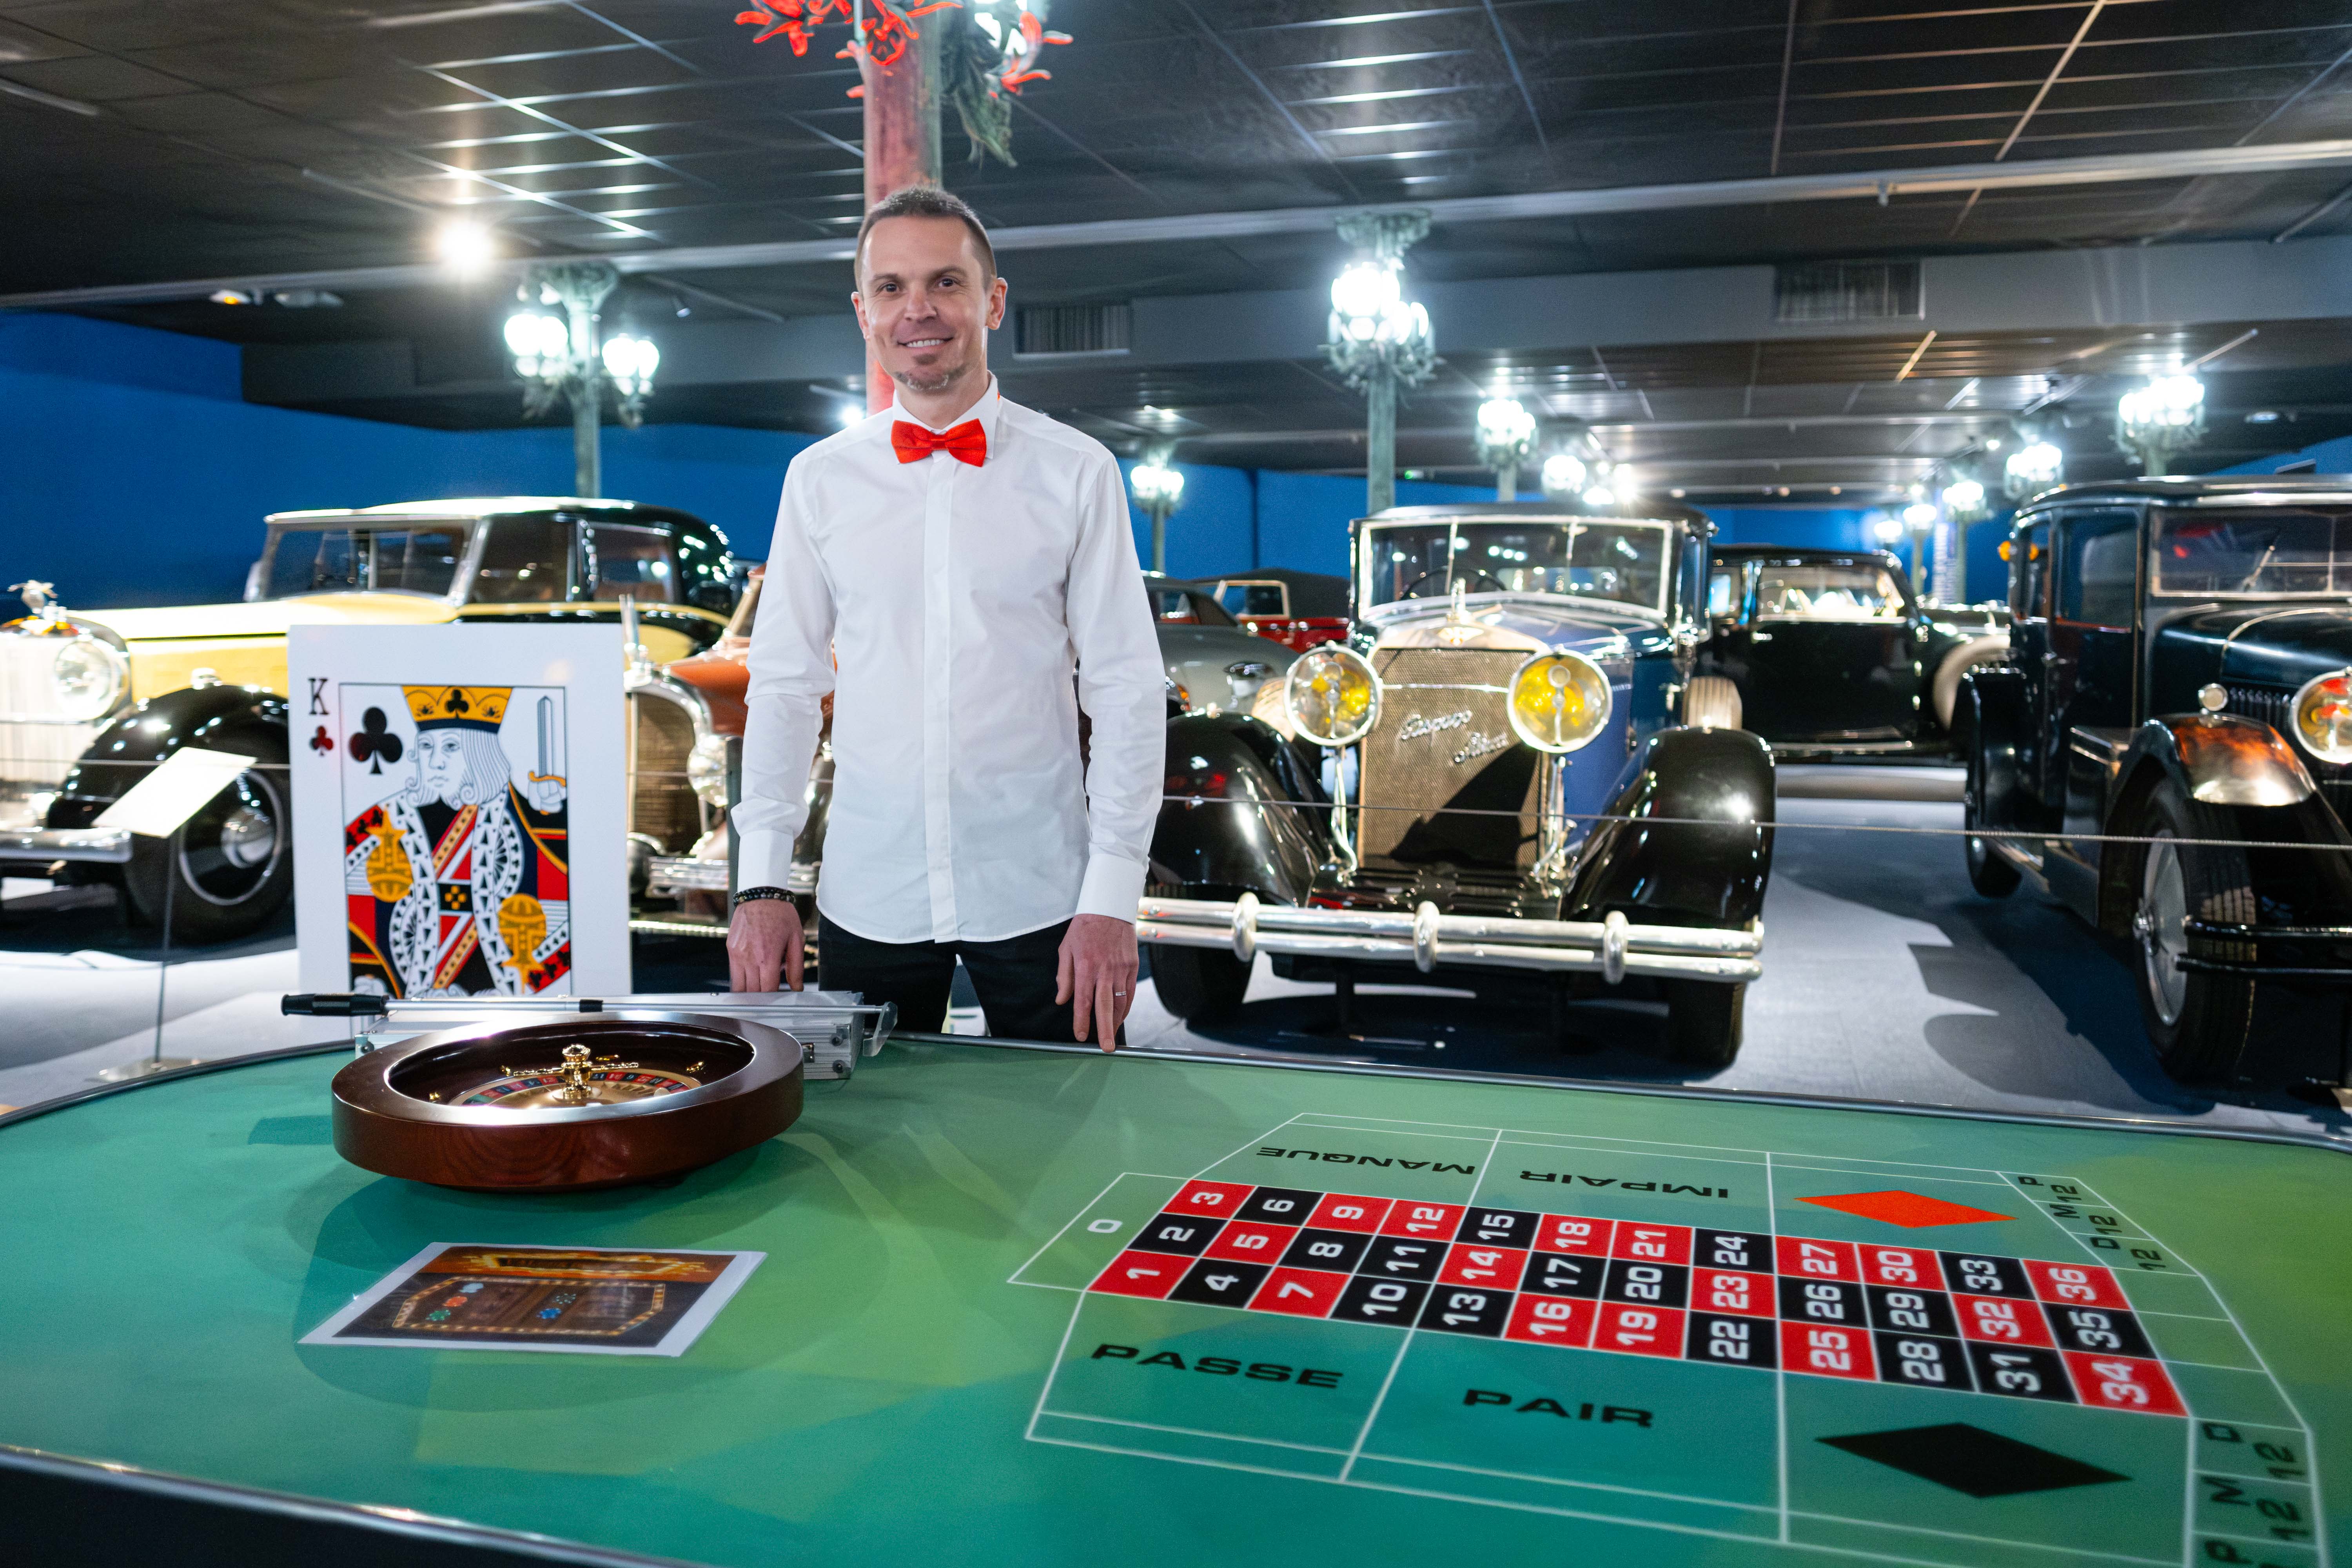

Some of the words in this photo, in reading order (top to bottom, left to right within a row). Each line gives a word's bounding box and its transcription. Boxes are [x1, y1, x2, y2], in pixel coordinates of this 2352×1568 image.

[308, 677, 329, 715] K
[1256, 1147, 1475, 1175] MANQUE
[1519, 1170, 1729, 1199] IMPAIR
[2018, 1176, 2044, 1186] P
[2050, 1184, 2082, 1202] 12
[1190, 1192, 1225, 1205] 3
[1261, 1199, 1295, 1212] 6
[1331, 1205, 1365, 1220] 9
[2049, 1204, 2080, 1219] M
[1085, 1218, 1124, 1234] 0
[1158, 1226, 1196, 1242] 2
[1405, 1207, 1446, 1232] 12
[1477, 1214, 1515, 1240] 15
[2088, 1215, 2122, 1234] 12
[1232, 1234, 1270, 1250] 5
[1307, 1242, 1344, 1258] 8
[1554, 1221, 1592, 1249] 18
[1631, 1230, 1667, 1258] 21
[2089, 1237, 2121, 1250] D
[1385, 1245, 1427, 1271] 11
[1460, 1250, 1503, 1280] 14
[1713, 1236, 1748, 1266] 24
[1800, 1243, 1838, 1275] 27
[1876, 1250, 1918, 1282] 30
[2130, 1248, 2166, 1271] 12
[1126, 1268, 1161, 1279] 1
[1204, 1275, 1239, 1291] 4
[1543, 1258, 1581, 1288] 17
[1624, 1266, 1663, 1300] 20
[1959, 1259, 2003, 1291] 33
[2048, 1267, 2096, 1301] 36
[1278, 1281, 1314, 1299] 7
[1361, 1284, 1407, 1316] 10
[1711, 1275, 1749, 1309] 23
[1804, 1284, 1844, 1319] 26
[1442, 1293, 1486, 1325] 13
[1529, 1301, 1572, 1336] 16
[1886, 1292, 1929, 1328] 29
[1973, 1301, 2021, 1338] 32
[1615, 1310, 1657, 1346] 19
[1710, 1321, 1749, 1359] 22
[2069, 1311, 2120, 1348] 35
[1808, 1330, 1851, 1371] 25
[1898, 1341, 1944, 1381] 28
[1091, 1343, 1345, 1390] PASSE
[1991, 1354, 2040, 1391] 31
[2091, 1362, 2148, 1404] 34
[1462, 1388, 1654, 1429] PAIR
[2201, 1422, 2243, 1443] D
[2252, 1442, 2306, 1480] 12
[2200, 1475, 2252, 1507] M
[2255, 1498, 2310, 1542] 12
[2203, 1539, 2254, 1566] P
